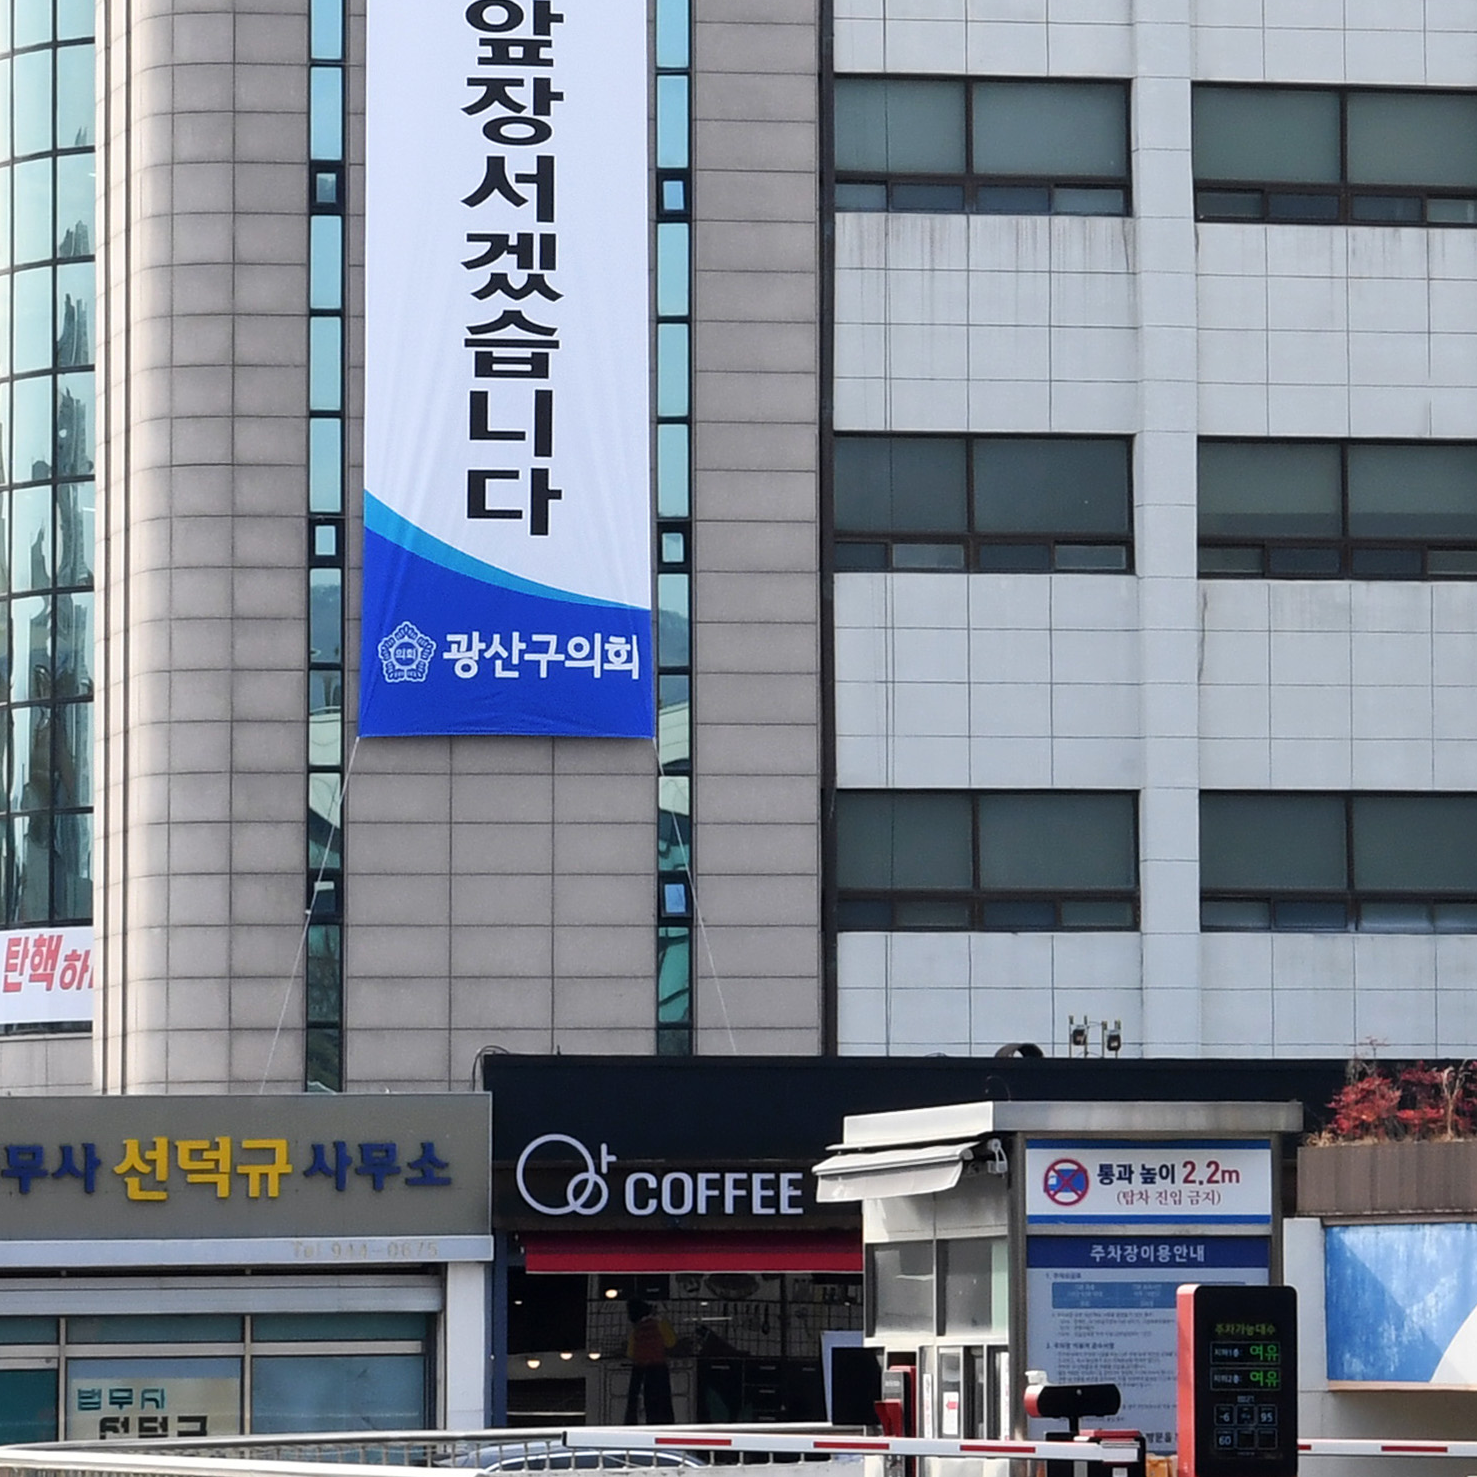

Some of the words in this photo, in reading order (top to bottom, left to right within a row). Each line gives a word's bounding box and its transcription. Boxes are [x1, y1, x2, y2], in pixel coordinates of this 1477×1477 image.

[394, 645, 417, 661] 의회
[442, 630, 640, 680] 광산구의회
[3, 934, 94, 994] 탄핵하
[113, 1136, 293, 1202] 선덕규
[303, 1139, 453, 1193] 사무소
[1096, 1163, 1135, 1185] 통과
[1139, 1163, 1176, 1185] 높이
[1181, 1160, 1241, 1186] 2.2m
[624, 1171, 805, 1216] COFFEE
[1116, 1189, 1150, 1206] (탑차
[1155, 1189, 1183, 1206] 진입
[1187, 1189, 1221, 1206] 금지)
[1089, 1243, 1205, 1263] 주차장이용안내
[1249, 1344, 1280, 1361] 여유
[1249, 1371, 1280, 1387] 여유
[77, 1388, 166, 1411] 법무사
